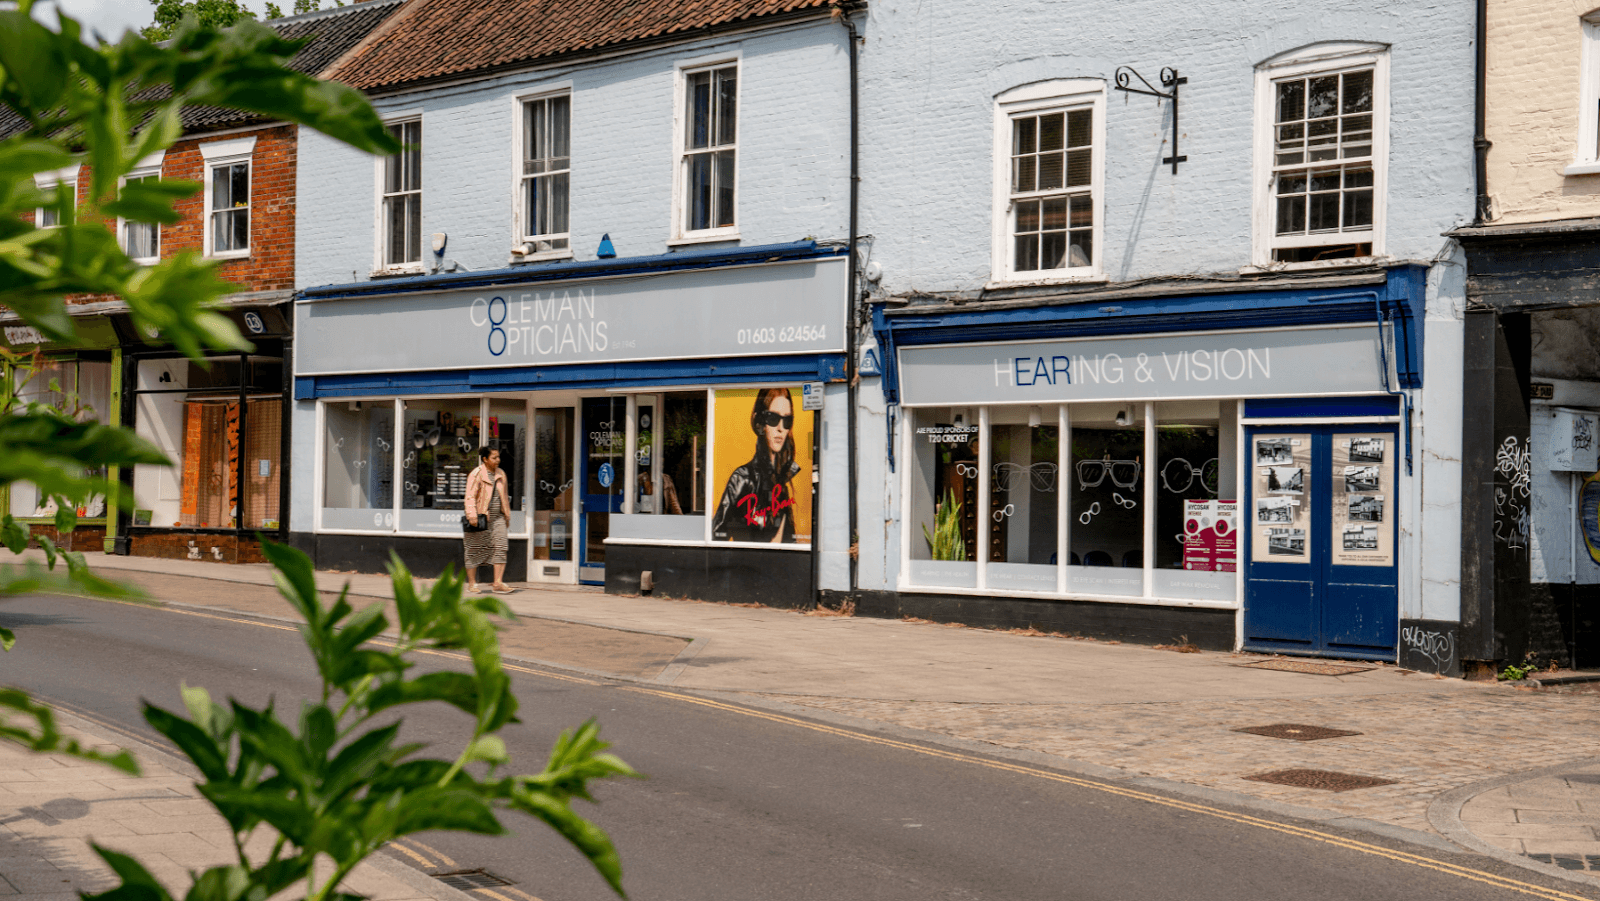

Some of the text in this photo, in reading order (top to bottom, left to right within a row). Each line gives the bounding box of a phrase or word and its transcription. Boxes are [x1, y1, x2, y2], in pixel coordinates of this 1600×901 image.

[470, 288, 595, 327] COLEMAN
[488, 321, 608, 356] OPTICIANS
[737, 325, 826, 345] 01603 624564
[993, 347, 1271, 387] HEARING & VISION
[928, 434, 969, 443] T20 CRICKET
